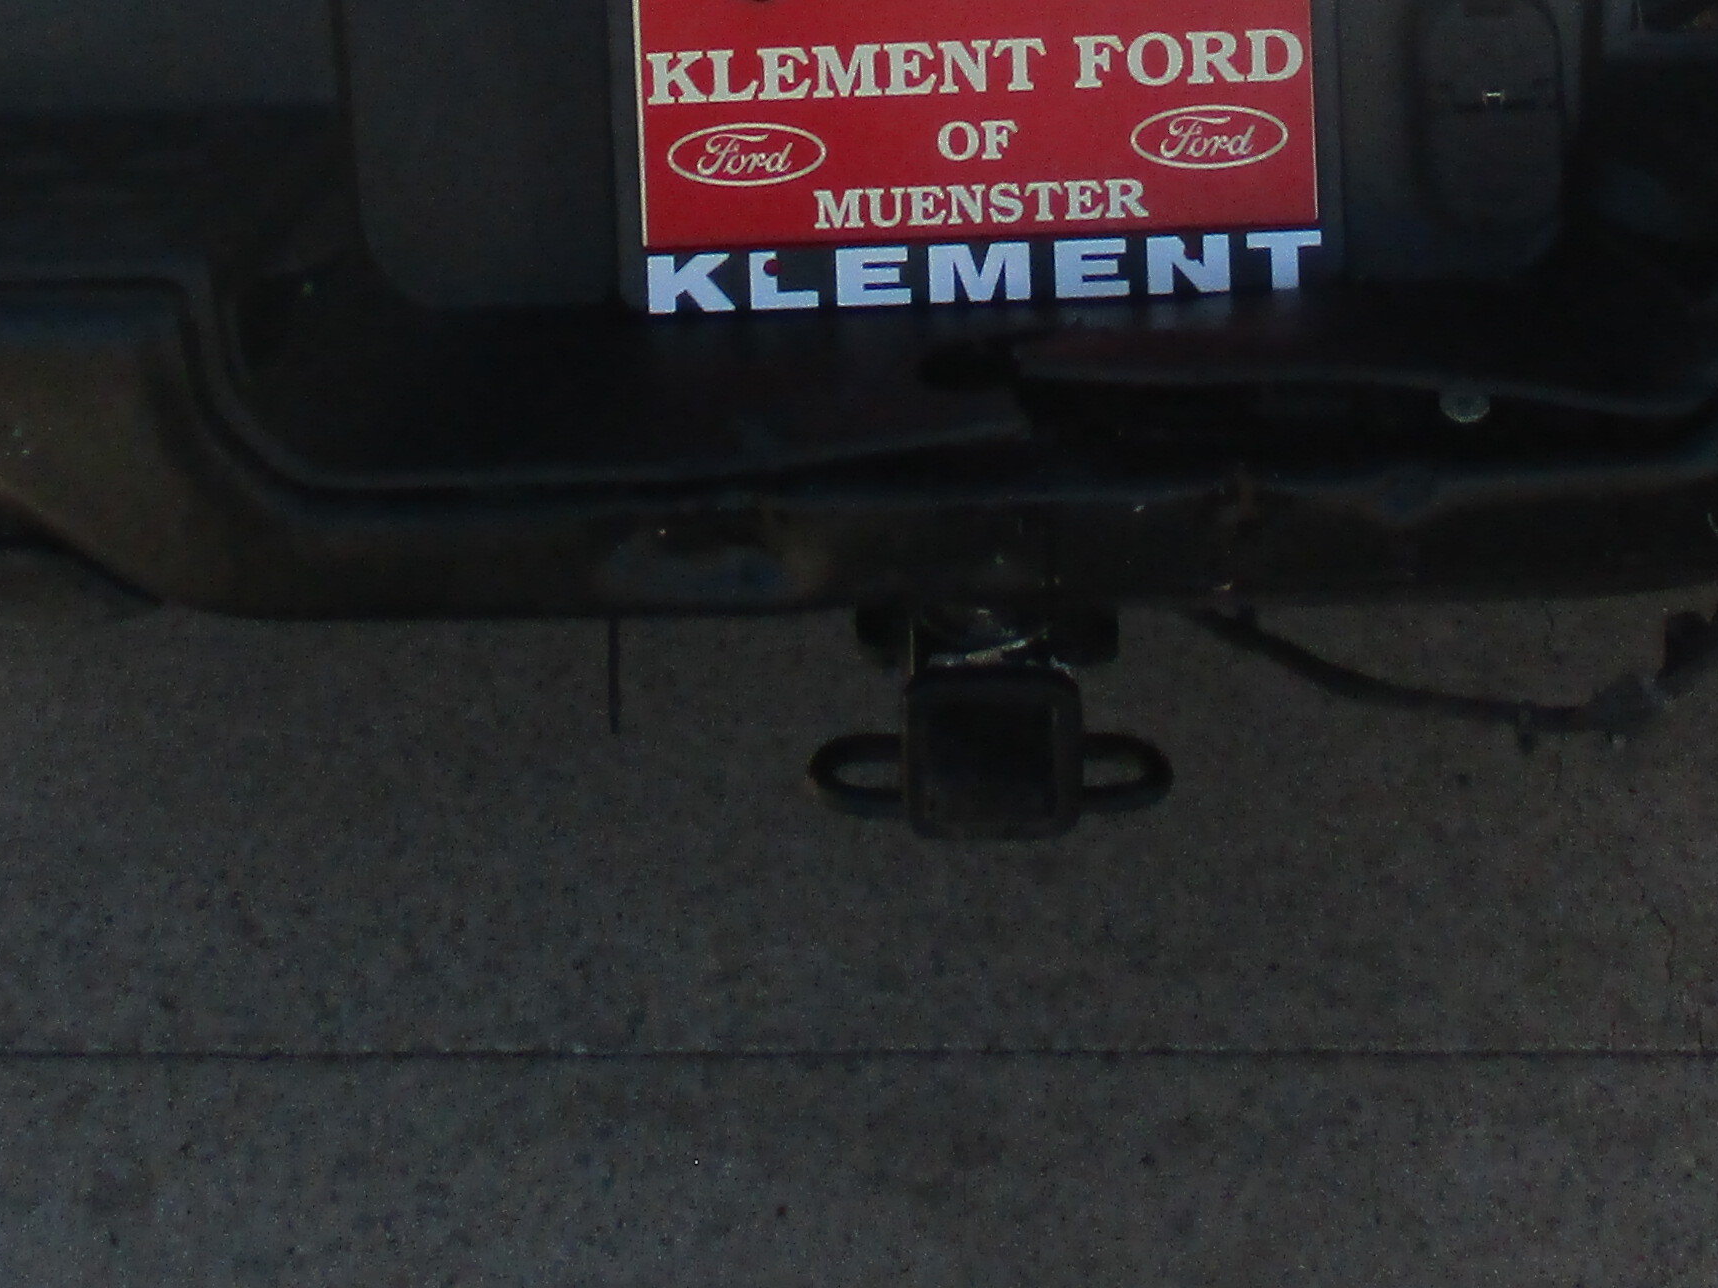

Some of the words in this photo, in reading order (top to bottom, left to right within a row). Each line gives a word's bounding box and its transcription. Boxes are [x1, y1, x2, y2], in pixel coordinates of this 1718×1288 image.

[646, 36, 1048, 106] KLEMENT
[1073, 28, 1305, 91] FORD
[696, 132, 793, 177] Ford
[936, 119, 1018, 162] OF
[1158, 114, 1257, 160] Ford
[812, 177, 1150, 231] MUENSTER
[646, 229, 1323, 316] KLEMENT
